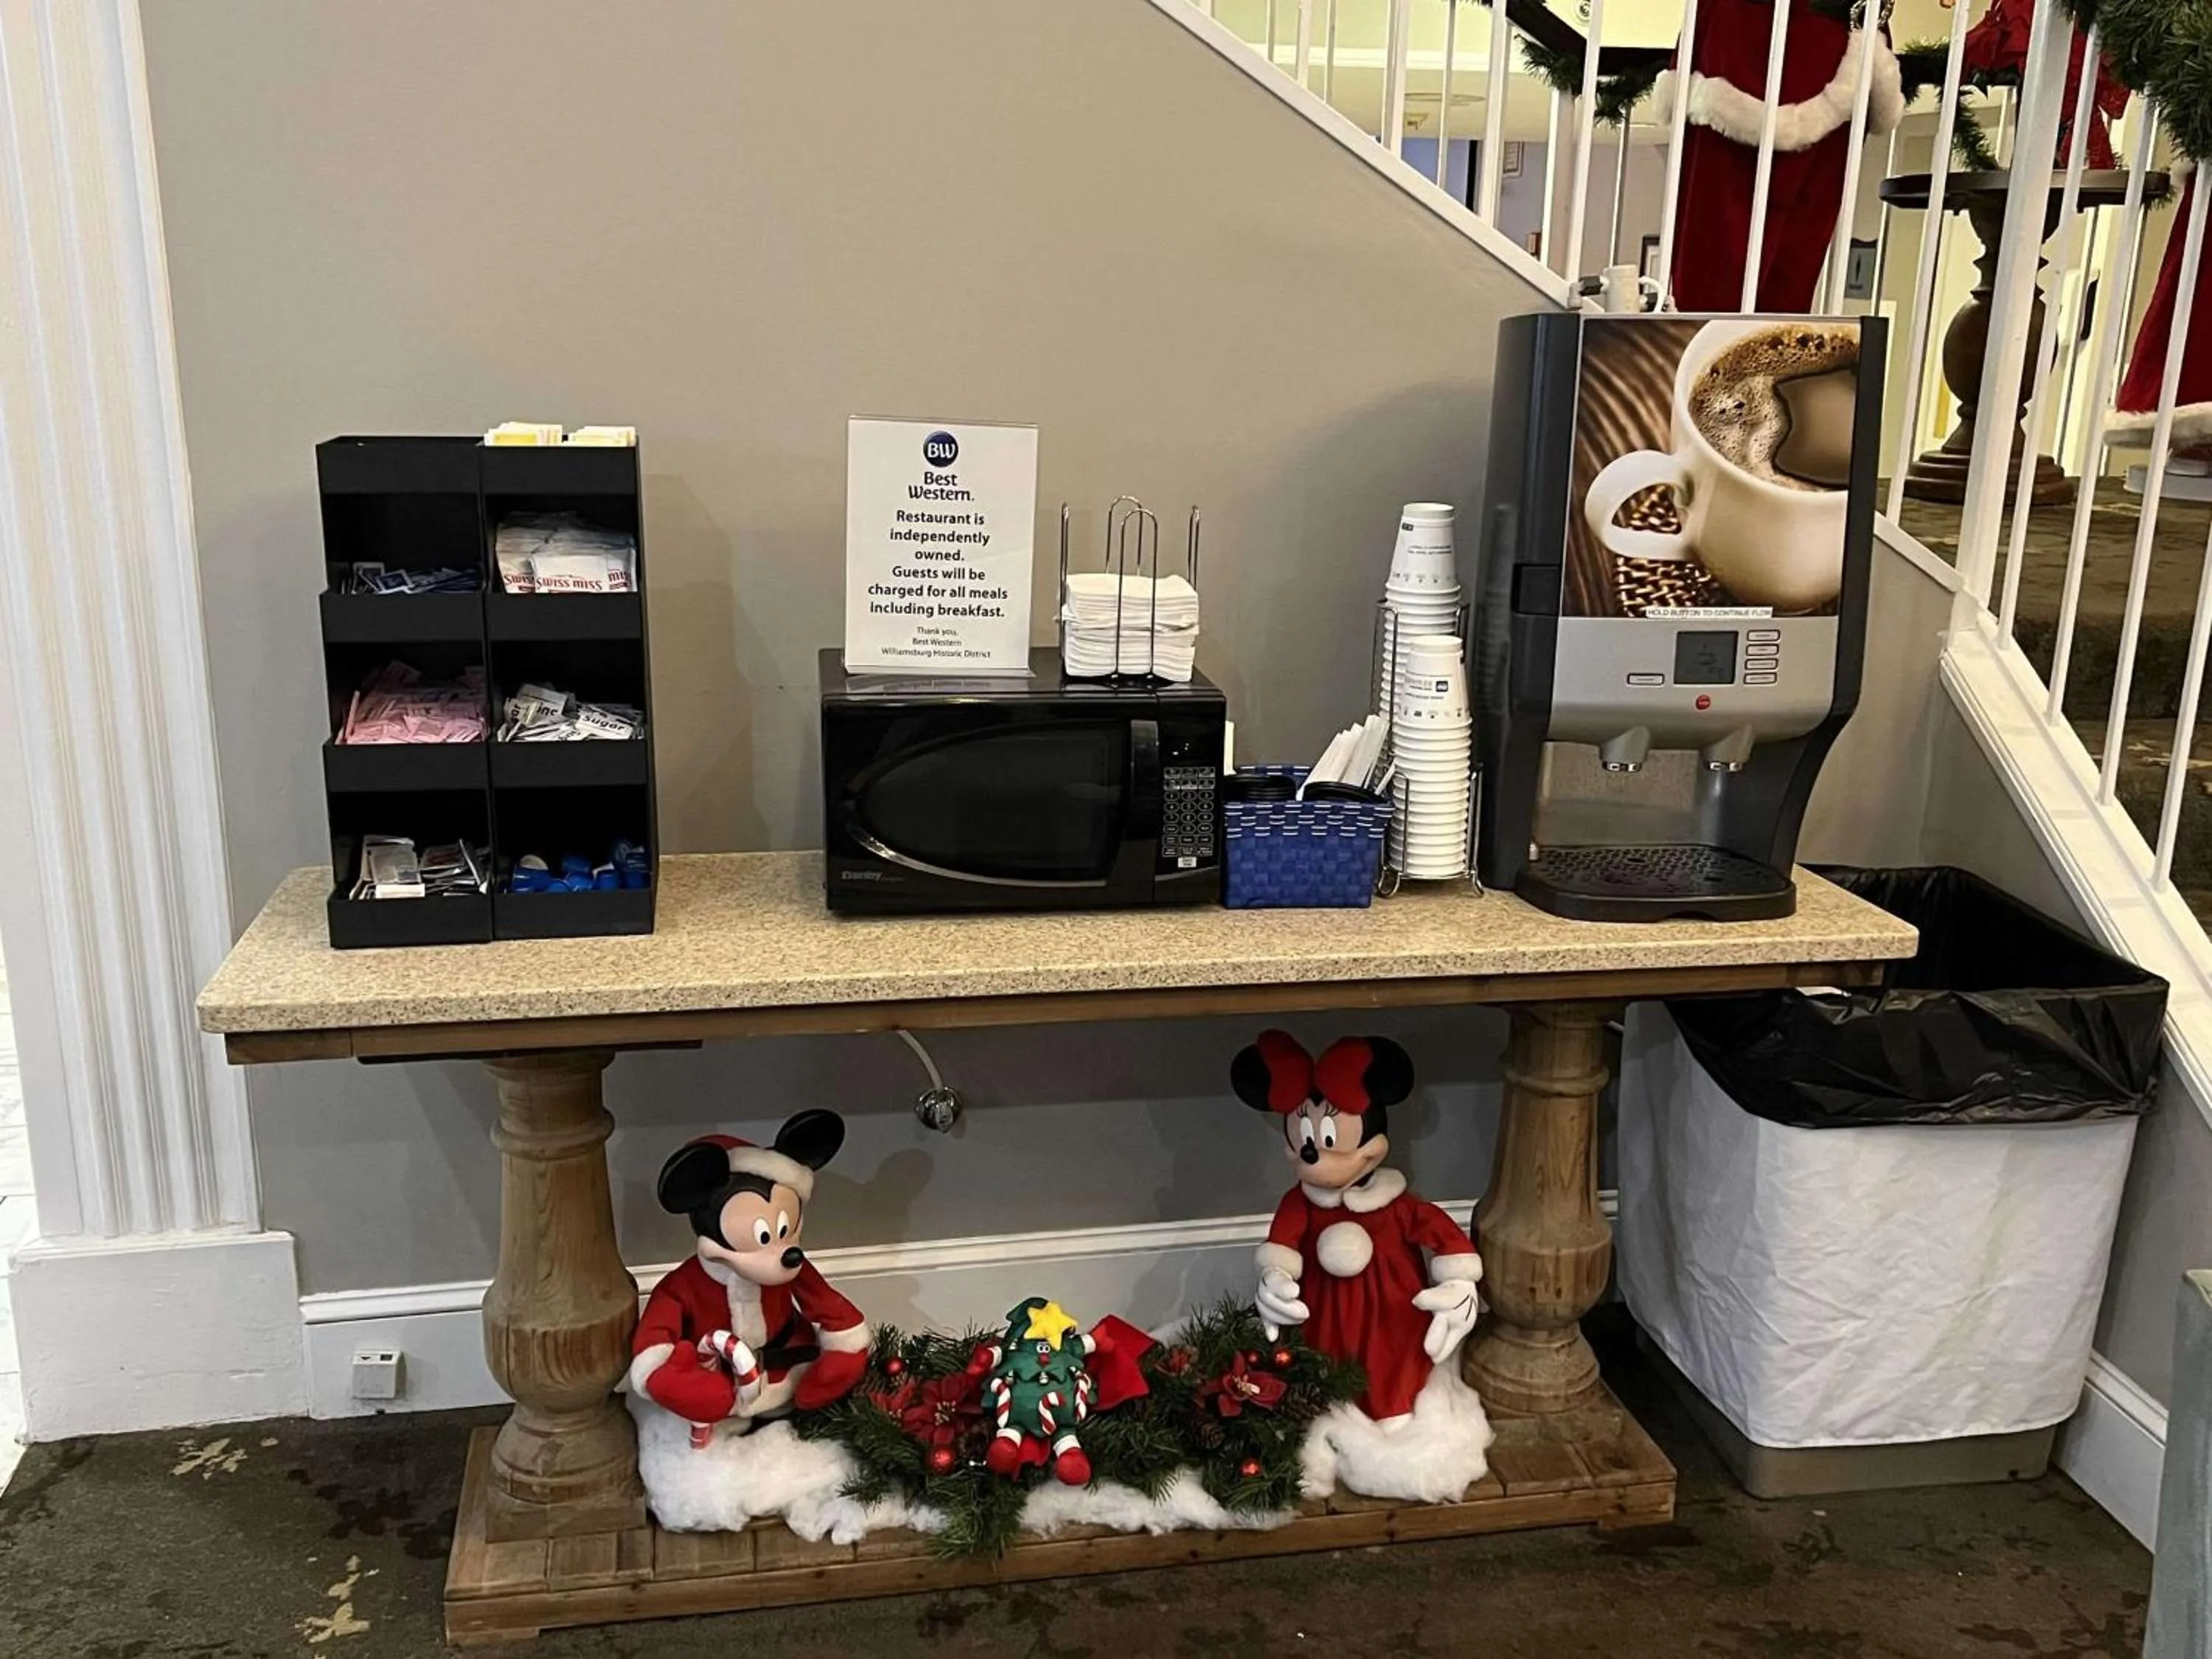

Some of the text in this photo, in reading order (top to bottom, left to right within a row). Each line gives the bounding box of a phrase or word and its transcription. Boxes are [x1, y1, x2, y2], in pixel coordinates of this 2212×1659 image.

[927, 442, 956, 459] BW
[924, 471, 958, 486] Best
[896, 509, 984, 525] Restaurant is
[890, 528, 990, 546] independently
[915, 549, 964, 561] owned.
[892, 566, 986, 580] Guests will be
[868, 584, 1008, 599] charged for all meals
[937, 603, 1005, 618] breakfast.
[917, 627, 940, 635] Thank
[912, 637, 962, 647] Best Western
[881, 647, 991, 658] Williamsburg Historic District
[582, 714, 626, 731] Sugar
